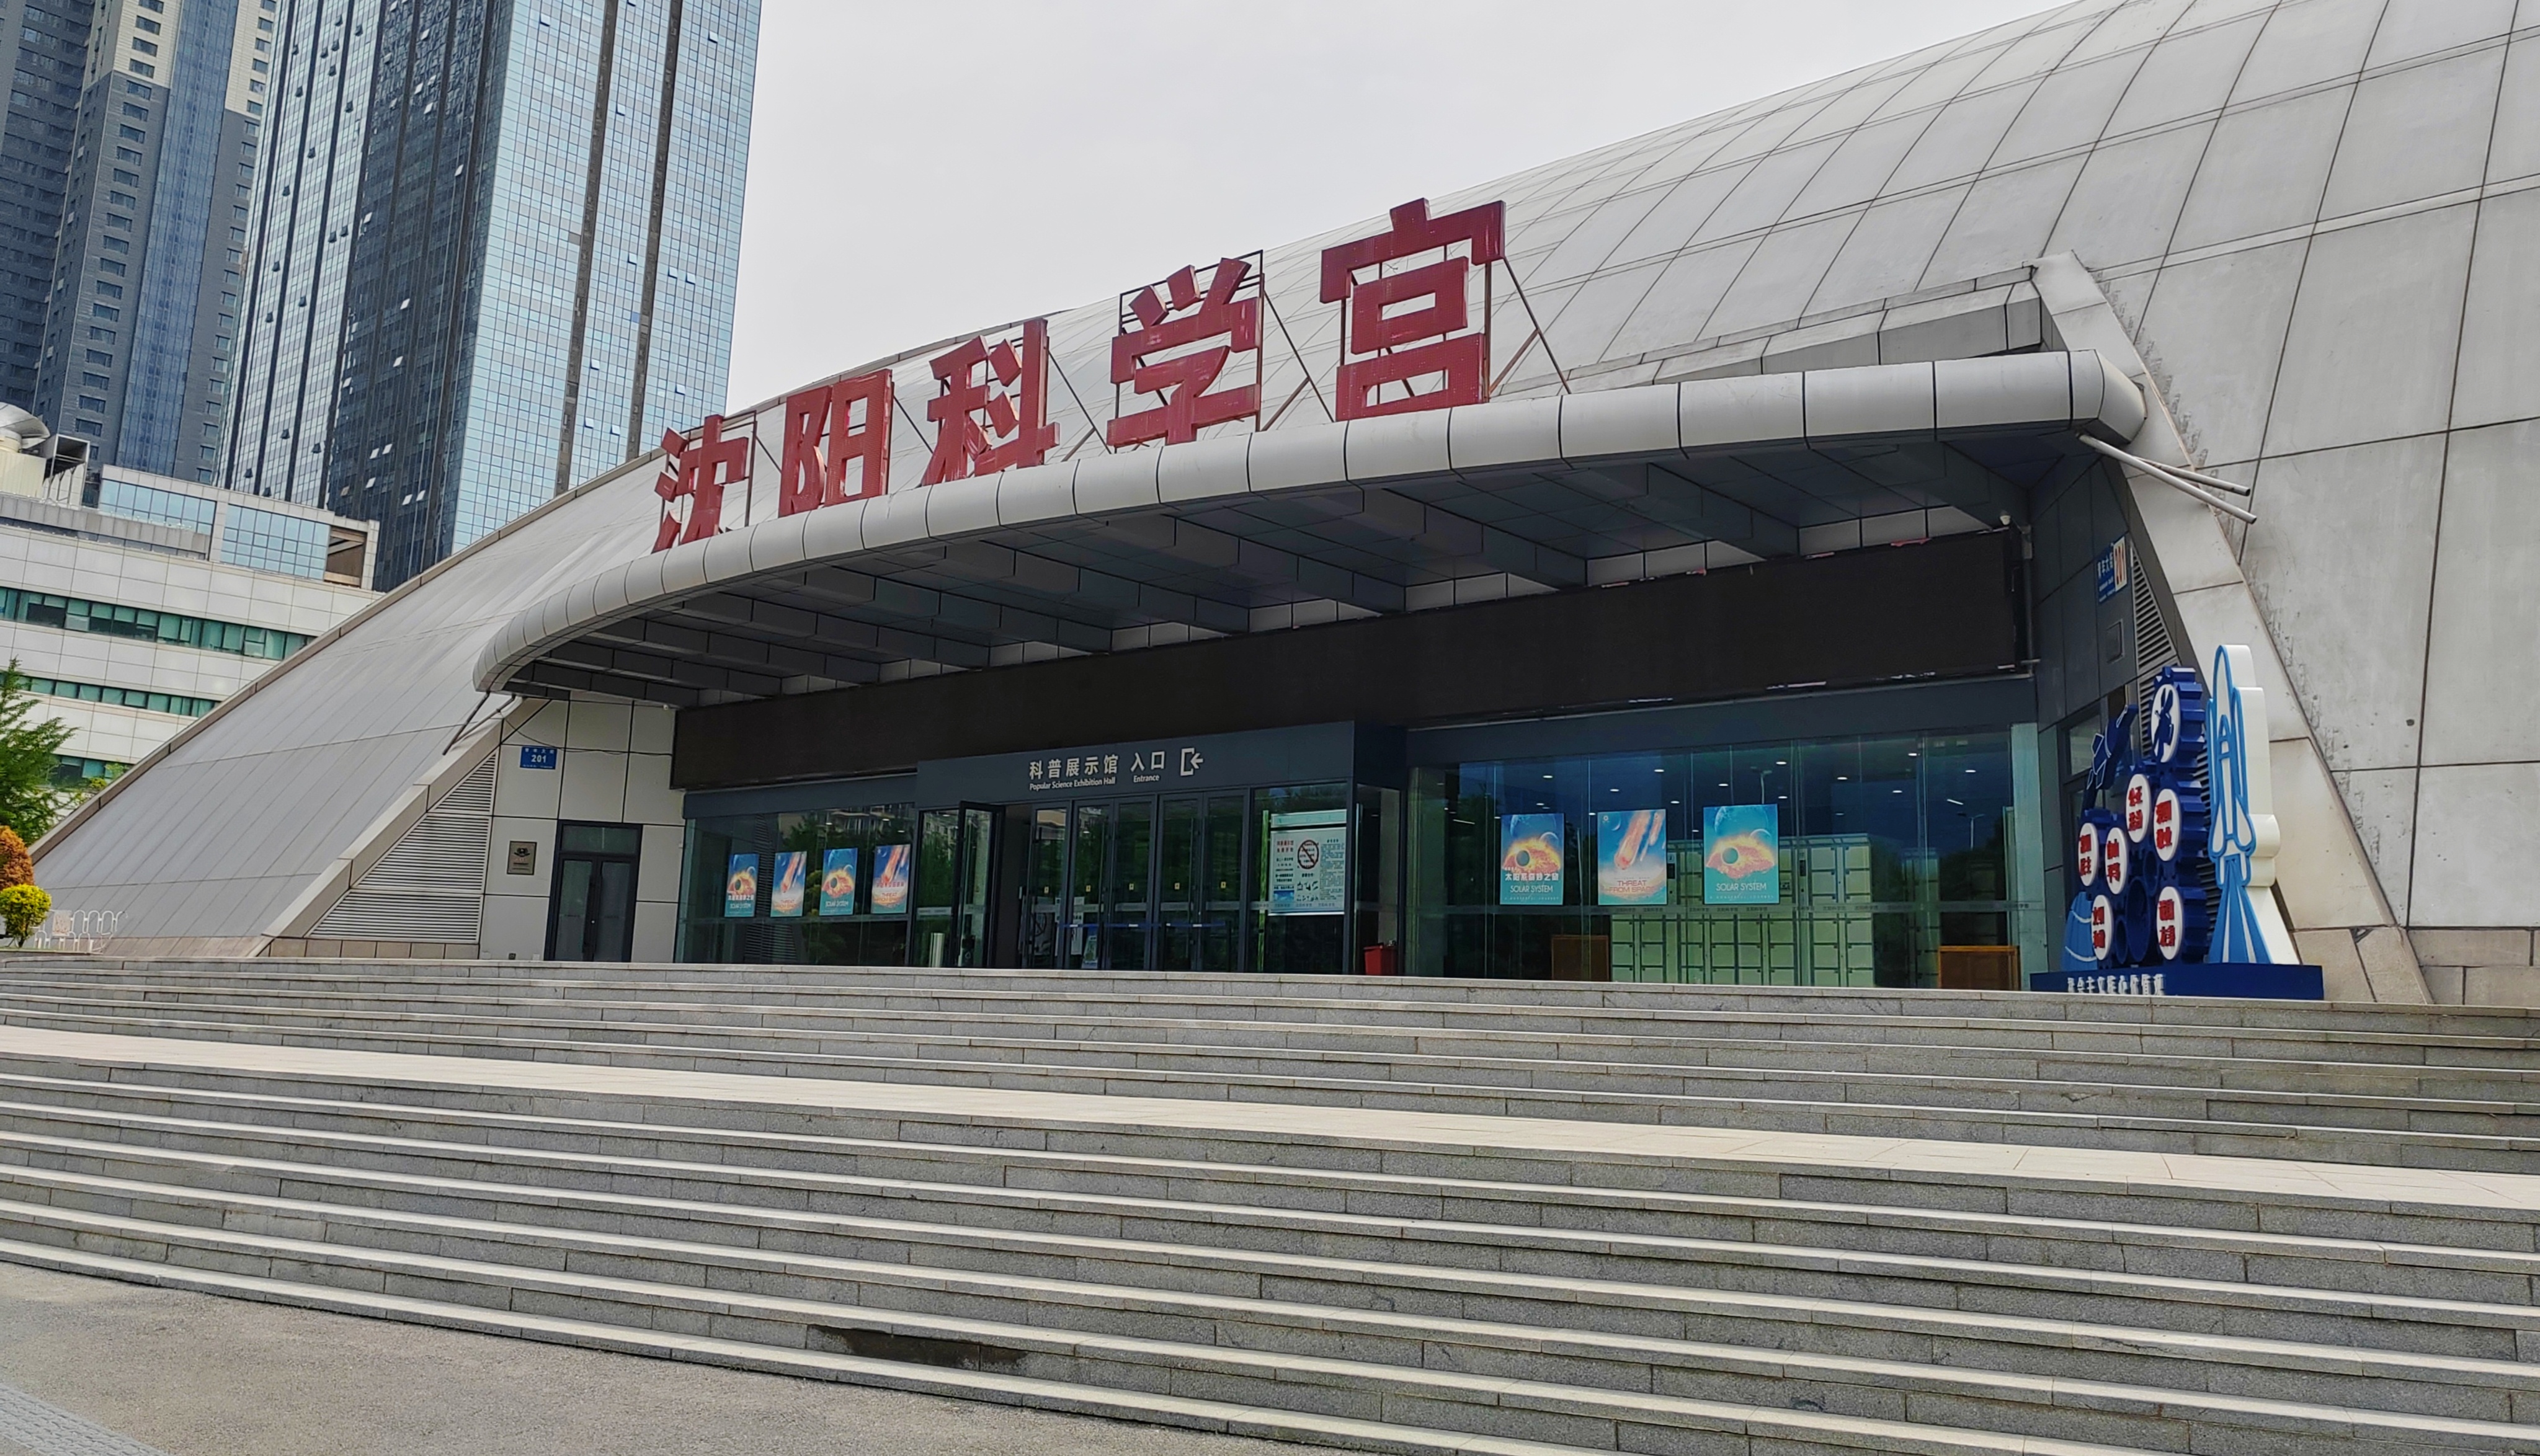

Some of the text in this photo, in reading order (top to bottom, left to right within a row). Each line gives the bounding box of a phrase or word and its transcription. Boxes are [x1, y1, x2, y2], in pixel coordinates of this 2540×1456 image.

[651, 197, 1506, 553] 沈阳科学宫
[531, 754, 546, 763] 201
[1029, 751, 1165, 780] 科普展示馆 入口
[1133, 774, 1160, 783] Entrance
[1029, 776, 1116, 791] Popular Science Exhibition Hall
[1510, 884, 1553, 893] SOLAR SYSTEM
[1716, 882, 1767, 891] SOLAR SYSTEM
